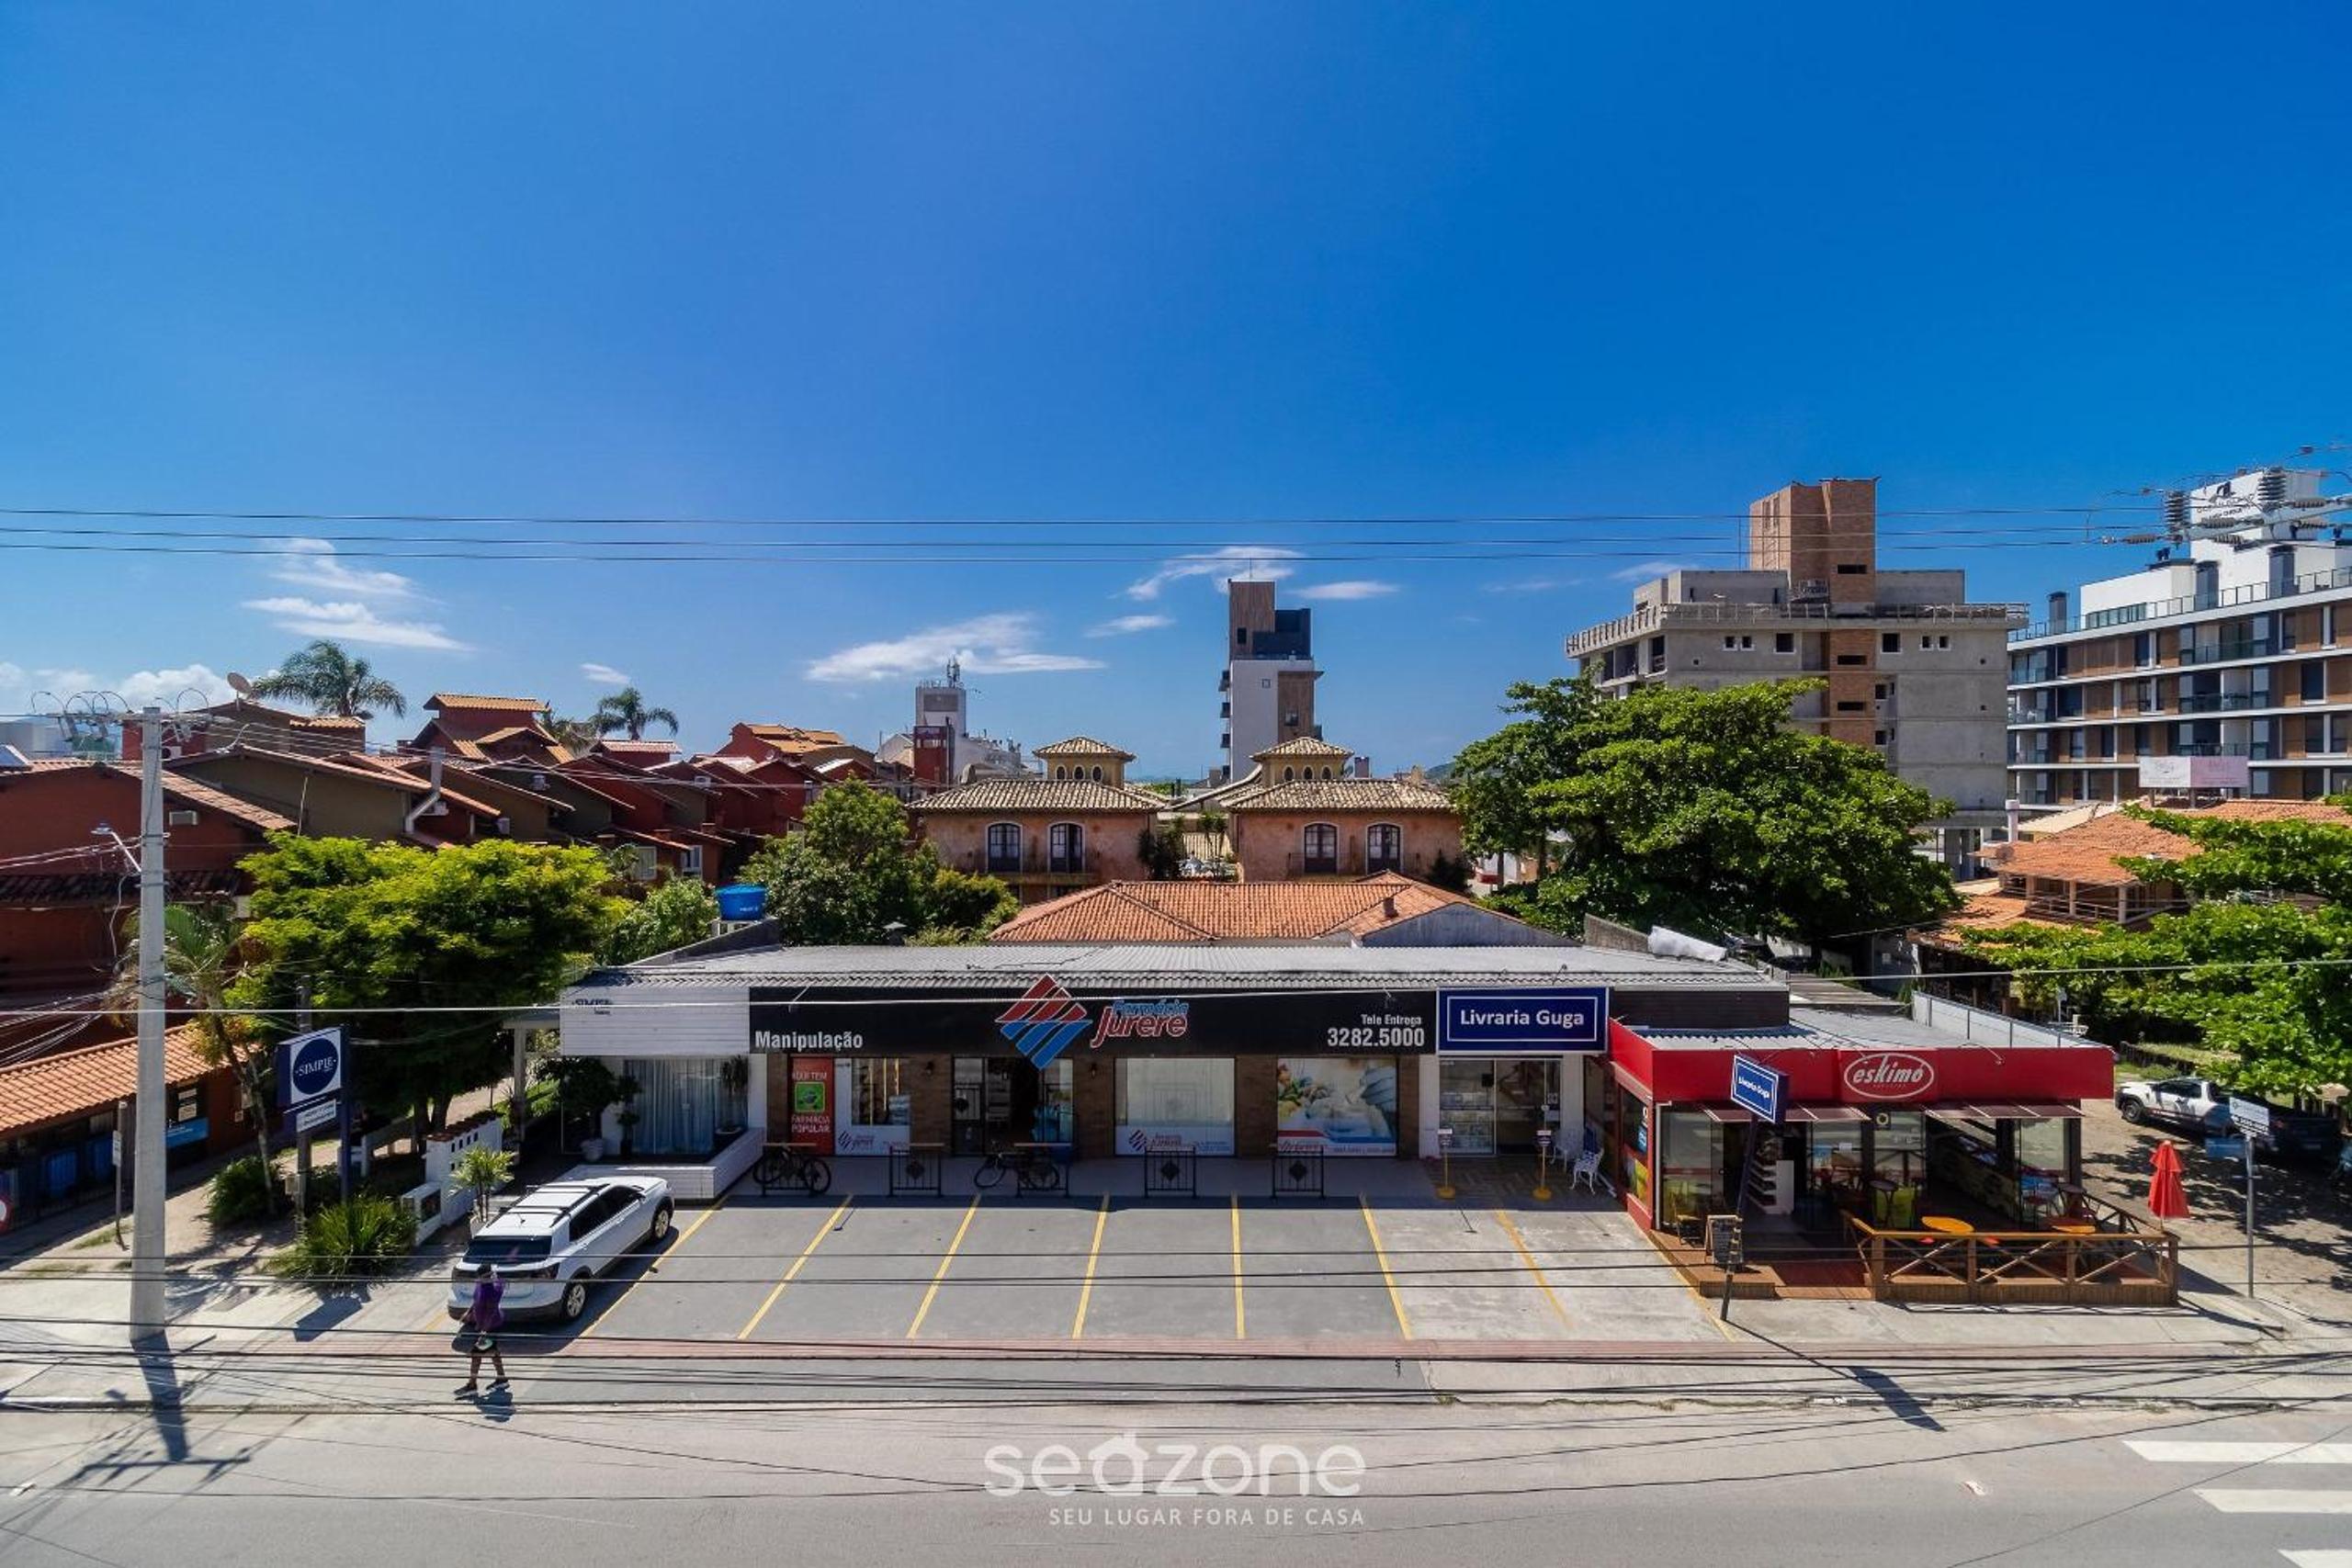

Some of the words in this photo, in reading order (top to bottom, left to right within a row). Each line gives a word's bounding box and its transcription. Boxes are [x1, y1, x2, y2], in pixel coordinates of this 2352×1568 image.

[1361, 1014, 1382, 1025] Tele
[1385, 1014, 1422, 1028] Entrega
[1461, 1010, 1530, 1025] Livraria
[1536, 1010, 1585, 1029] Guga
[755, 1031, 863, 1053] Manipulação
[1327, 1027, 1425, 1047] 3282.5000
[1853, 1054, 1925, 1083] eskimo
